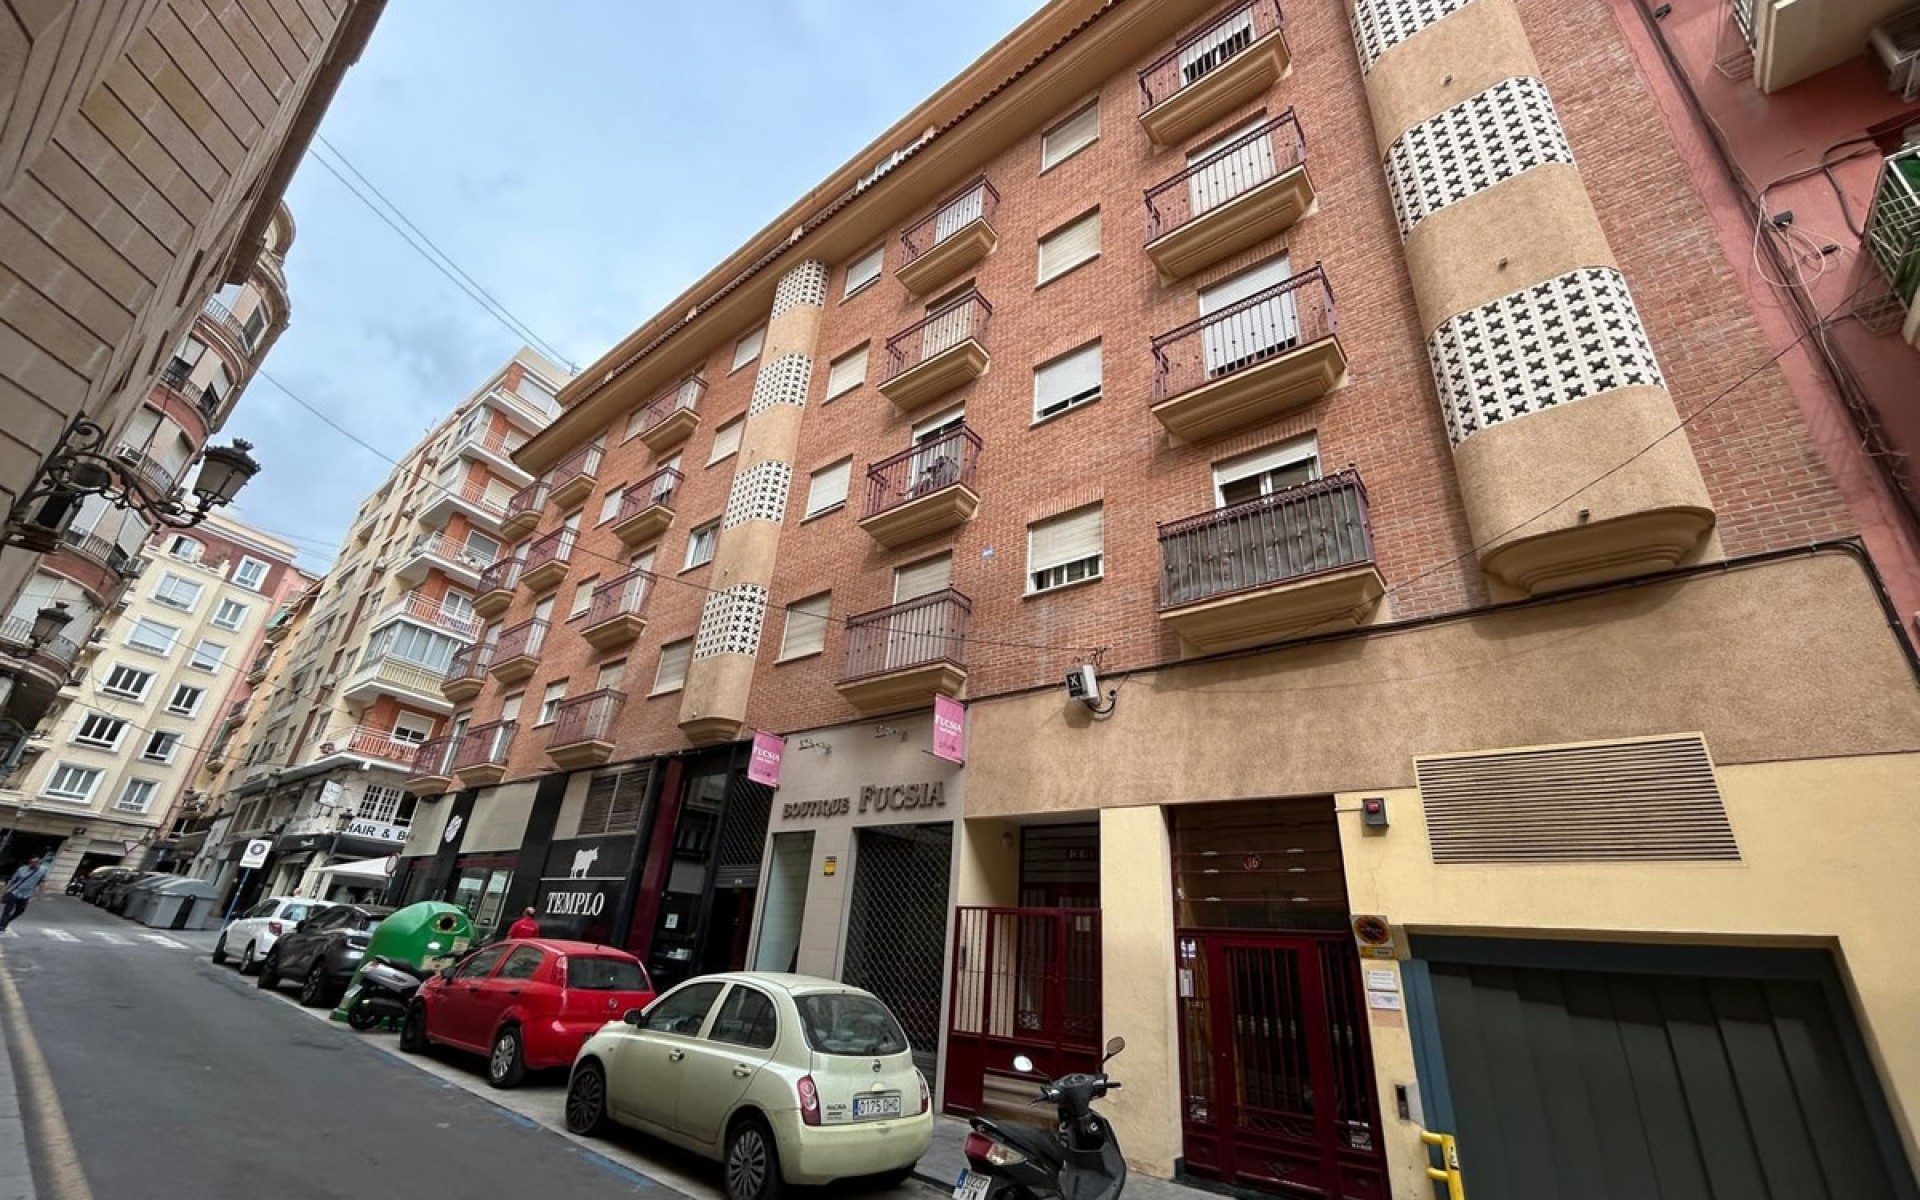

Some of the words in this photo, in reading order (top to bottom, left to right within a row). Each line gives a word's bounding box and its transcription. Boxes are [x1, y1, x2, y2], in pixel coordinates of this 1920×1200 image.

[935, 714, 962, 733] FUCSIA
[753, 746, 780, 762] FUCSIA
[782, 798, 850, 820] BOUTIQUE
[858, 781, 946, 815] FUCSIA
[382, 828, 390, 839] &
[545, 892, 605, 916] TEMPLO
[859, 1100, 881, 1116] 0175
